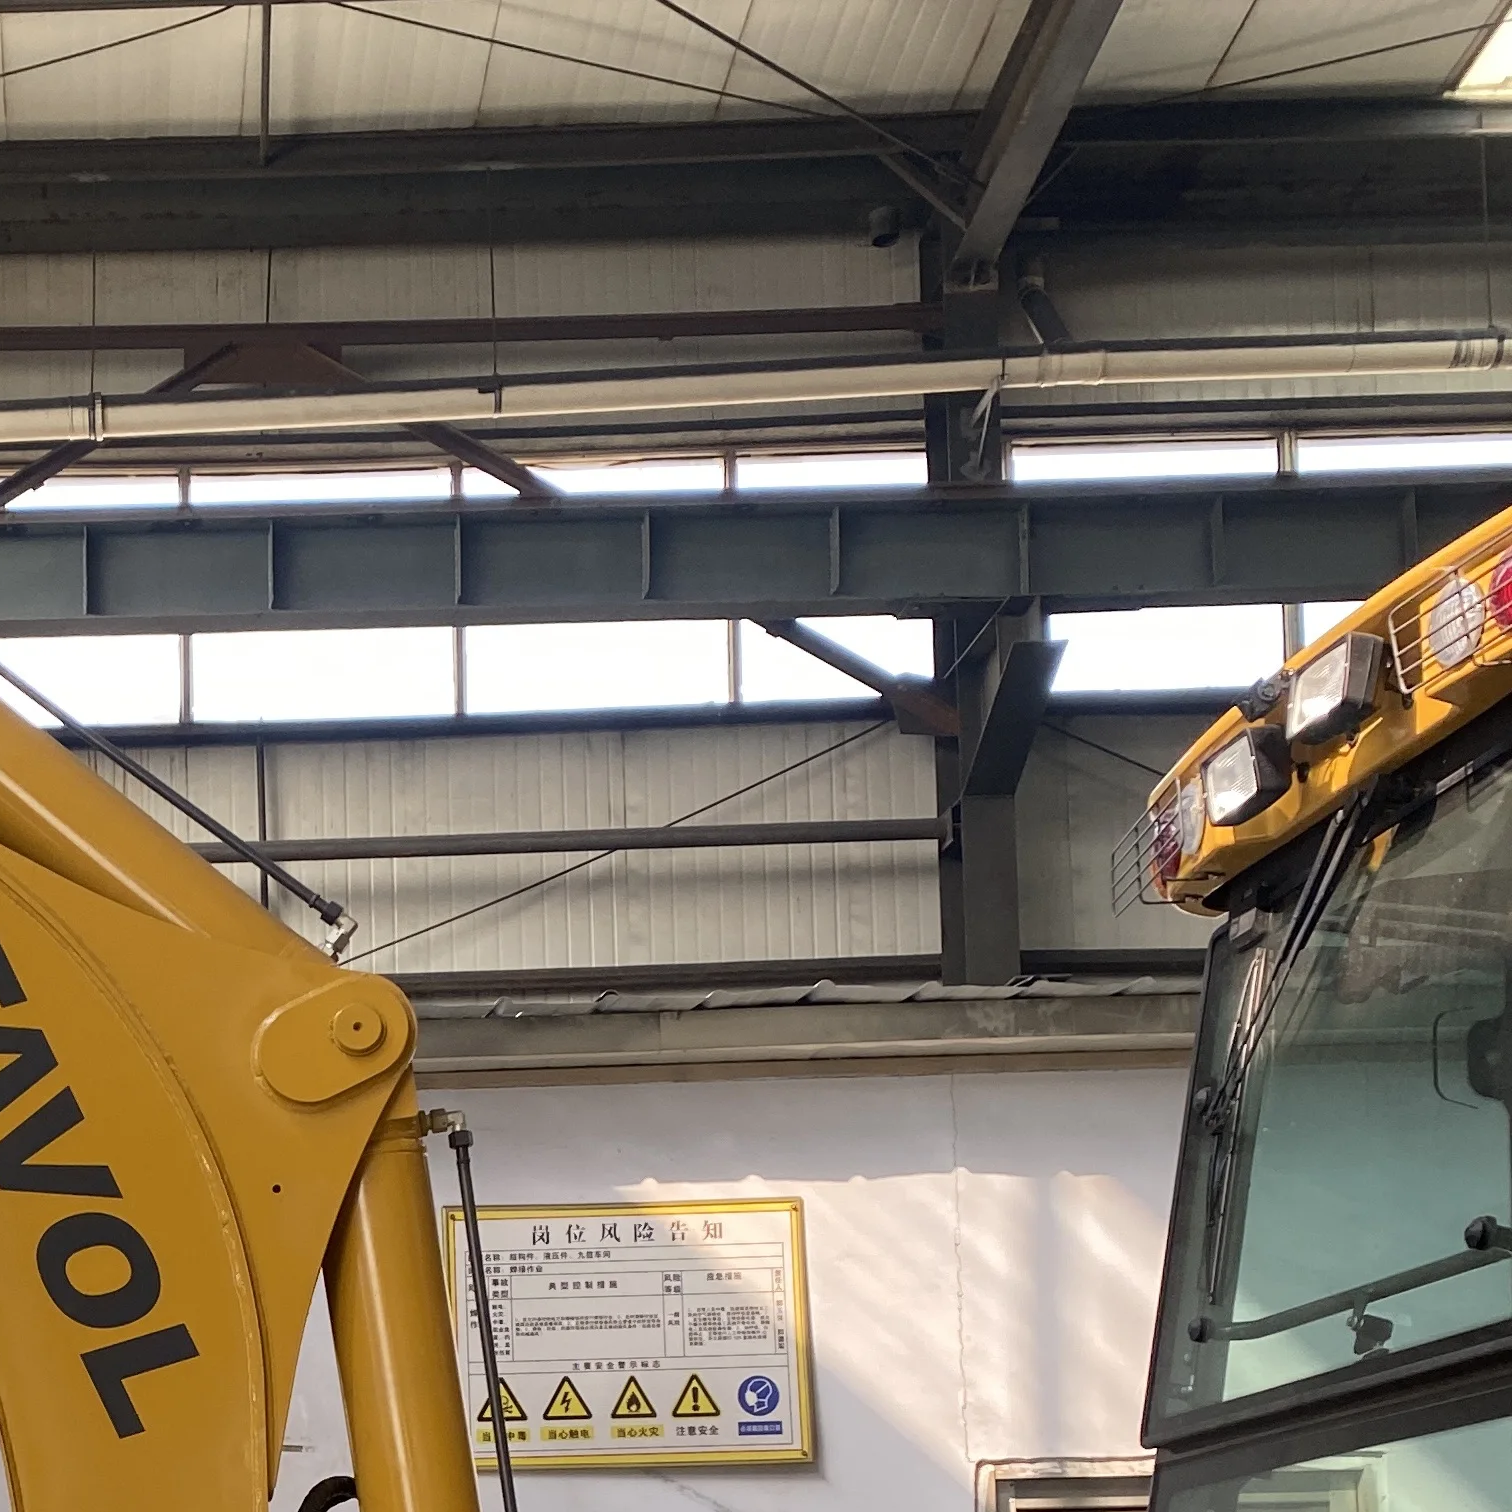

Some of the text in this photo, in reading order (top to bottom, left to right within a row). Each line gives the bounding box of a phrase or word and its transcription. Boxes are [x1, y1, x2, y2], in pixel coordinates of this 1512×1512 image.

[532, 1220, 723, 1245] 岗位风险告知
[548, 1280, 618, 1291] 典型控制措施
[572, 1360, 661, 1371] 主要安全警示标志
[482, 1431, 527, 1442] 当中毒
[548, 1429, 595, 1440] 当心触电
[616, 1426, 660, 1438] 当心火灾
[676, 1425, 719, 1437] 注意安全
